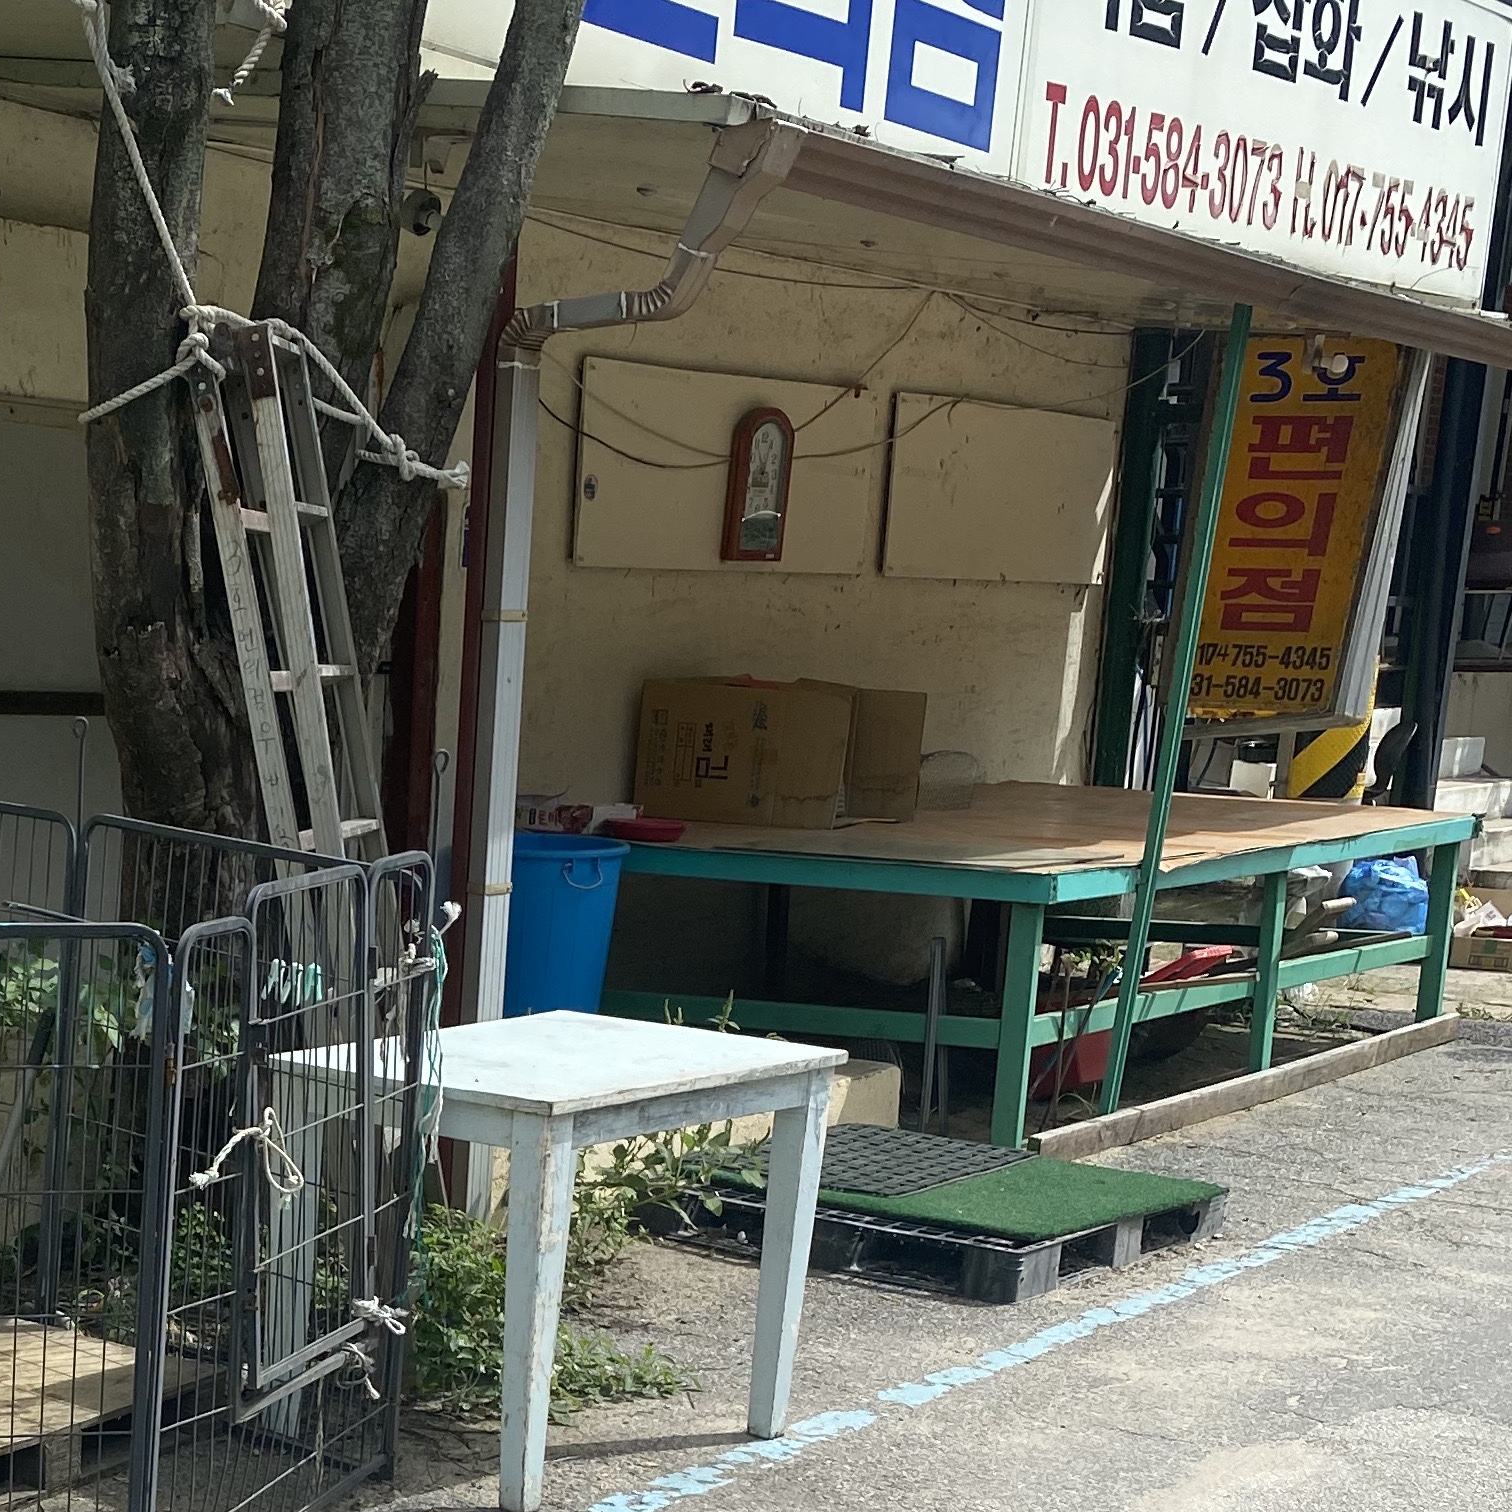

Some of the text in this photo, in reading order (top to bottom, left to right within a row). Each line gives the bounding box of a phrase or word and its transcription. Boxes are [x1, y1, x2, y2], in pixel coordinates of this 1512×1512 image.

[1407, 10, 1495, 147] 낚시
[1219, 415, 1355, 633] 편의점
[1190, 672, 1325, 702] 31-584-3073
